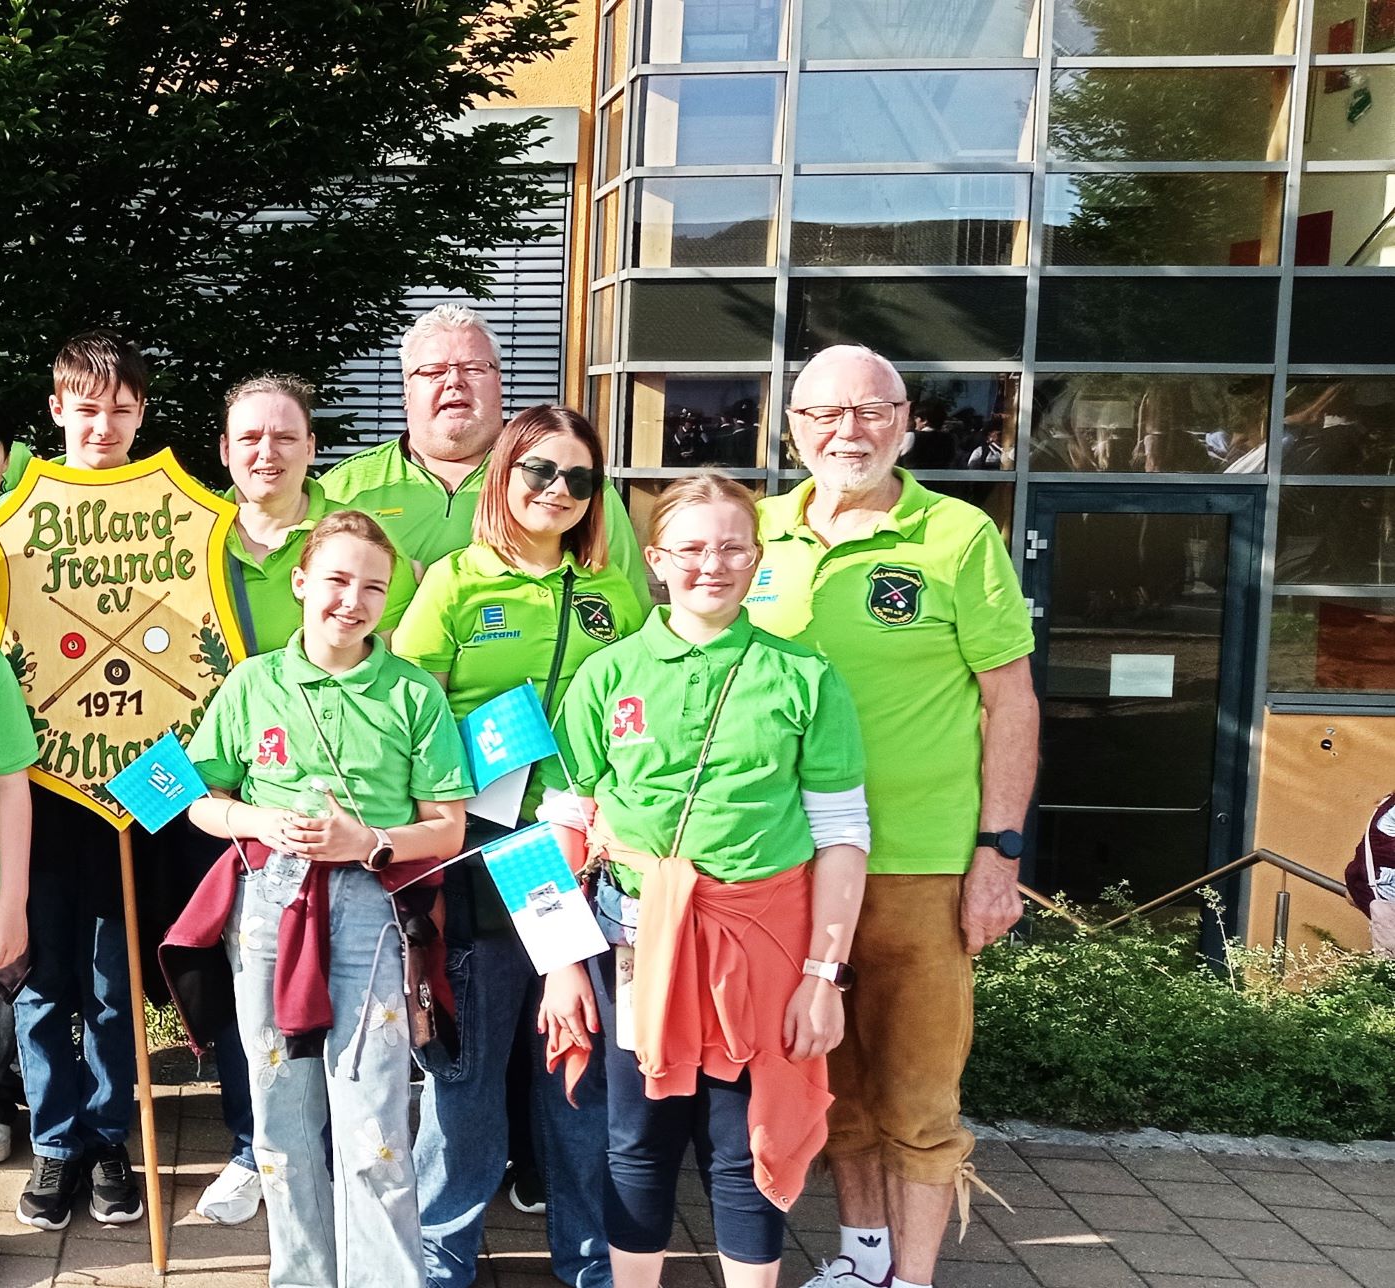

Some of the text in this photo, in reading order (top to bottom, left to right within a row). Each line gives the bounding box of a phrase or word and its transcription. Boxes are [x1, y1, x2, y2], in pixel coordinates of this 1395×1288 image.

[24, 493, 193, 558] Billard-
[42, 536, 196, 593] Freunde
[97, 586, 134, 614] e.V.
[76, 690, 144, 718] 1971
